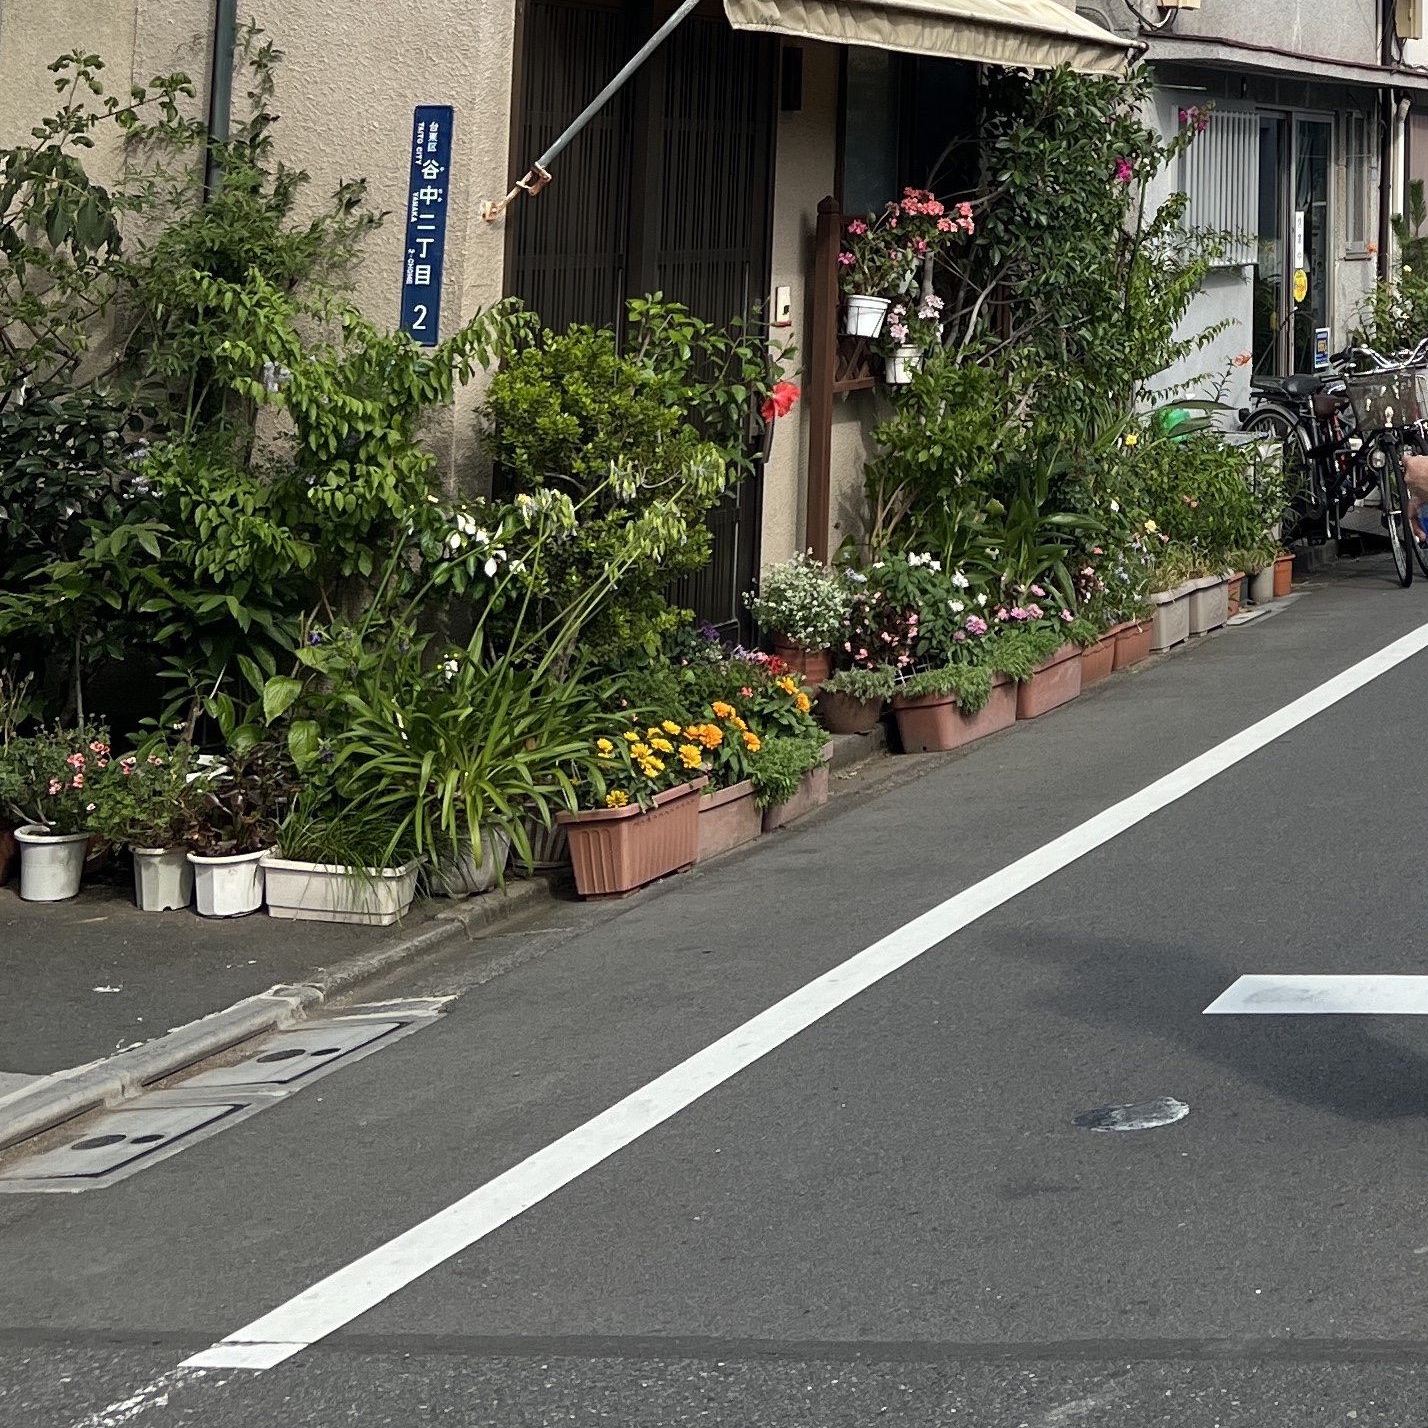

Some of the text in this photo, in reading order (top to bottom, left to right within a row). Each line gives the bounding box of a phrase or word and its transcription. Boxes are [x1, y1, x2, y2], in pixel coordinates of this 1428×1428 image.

[416, 121, 425, 144] TAITO
[415, 146, 423, 165] CITY
[412, 120, 440, 330] 台東区 谷中二丁目 2
